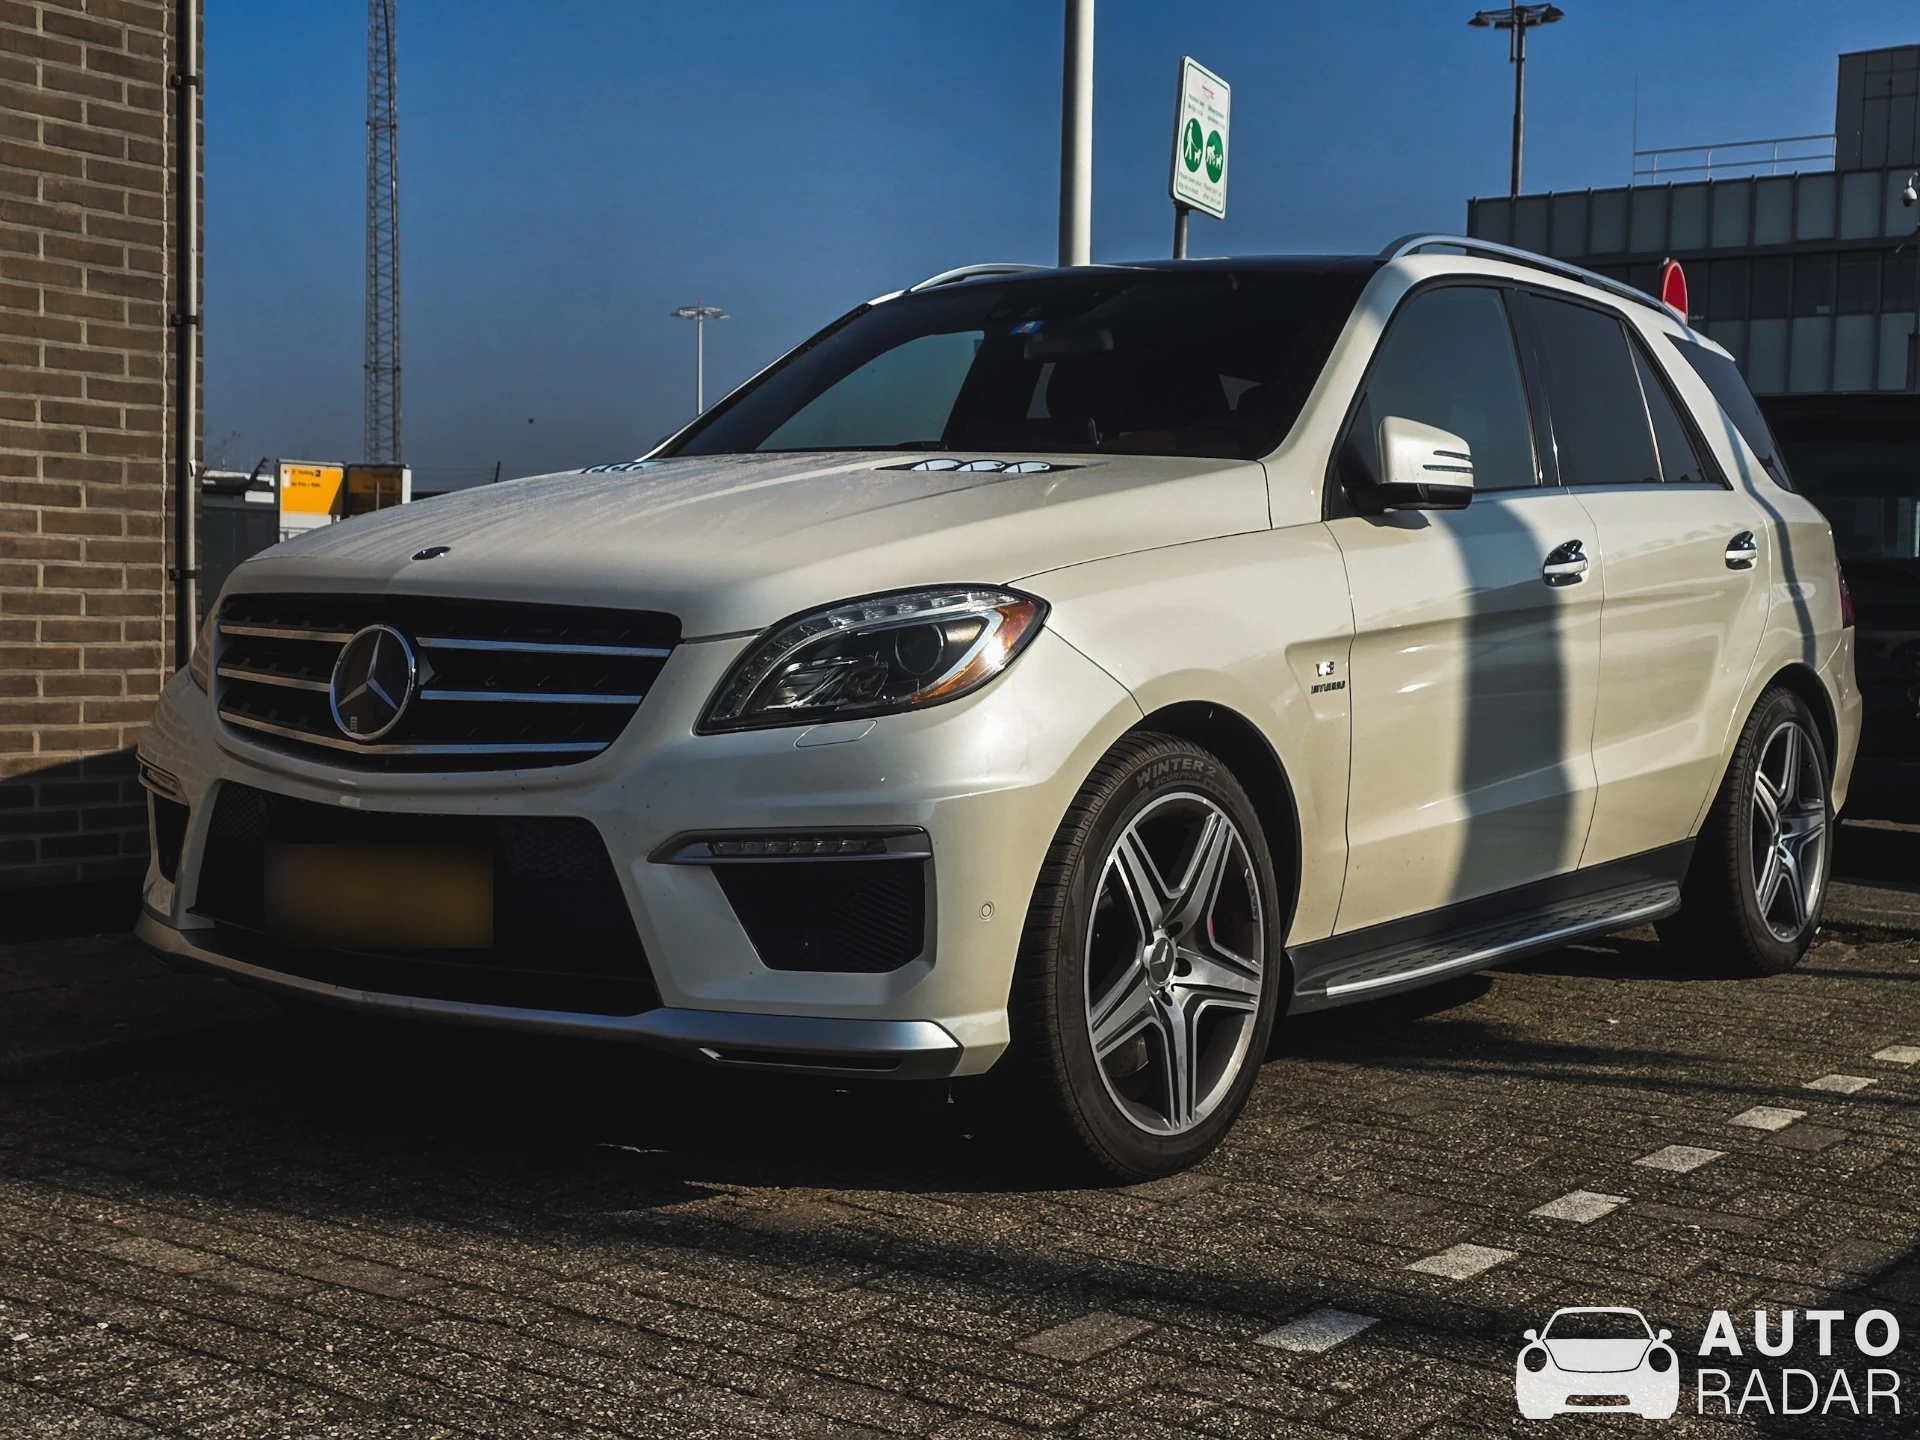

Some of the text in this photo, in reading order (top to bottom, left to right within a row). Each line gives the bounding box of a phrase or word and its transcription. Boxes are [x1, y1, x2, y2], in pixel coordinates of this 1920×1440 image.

[1136, 758, 1204, 788] WINTER
[1206, 766, 1217, 777] 2
[1154, 771, 1200, 788] SCORPION
